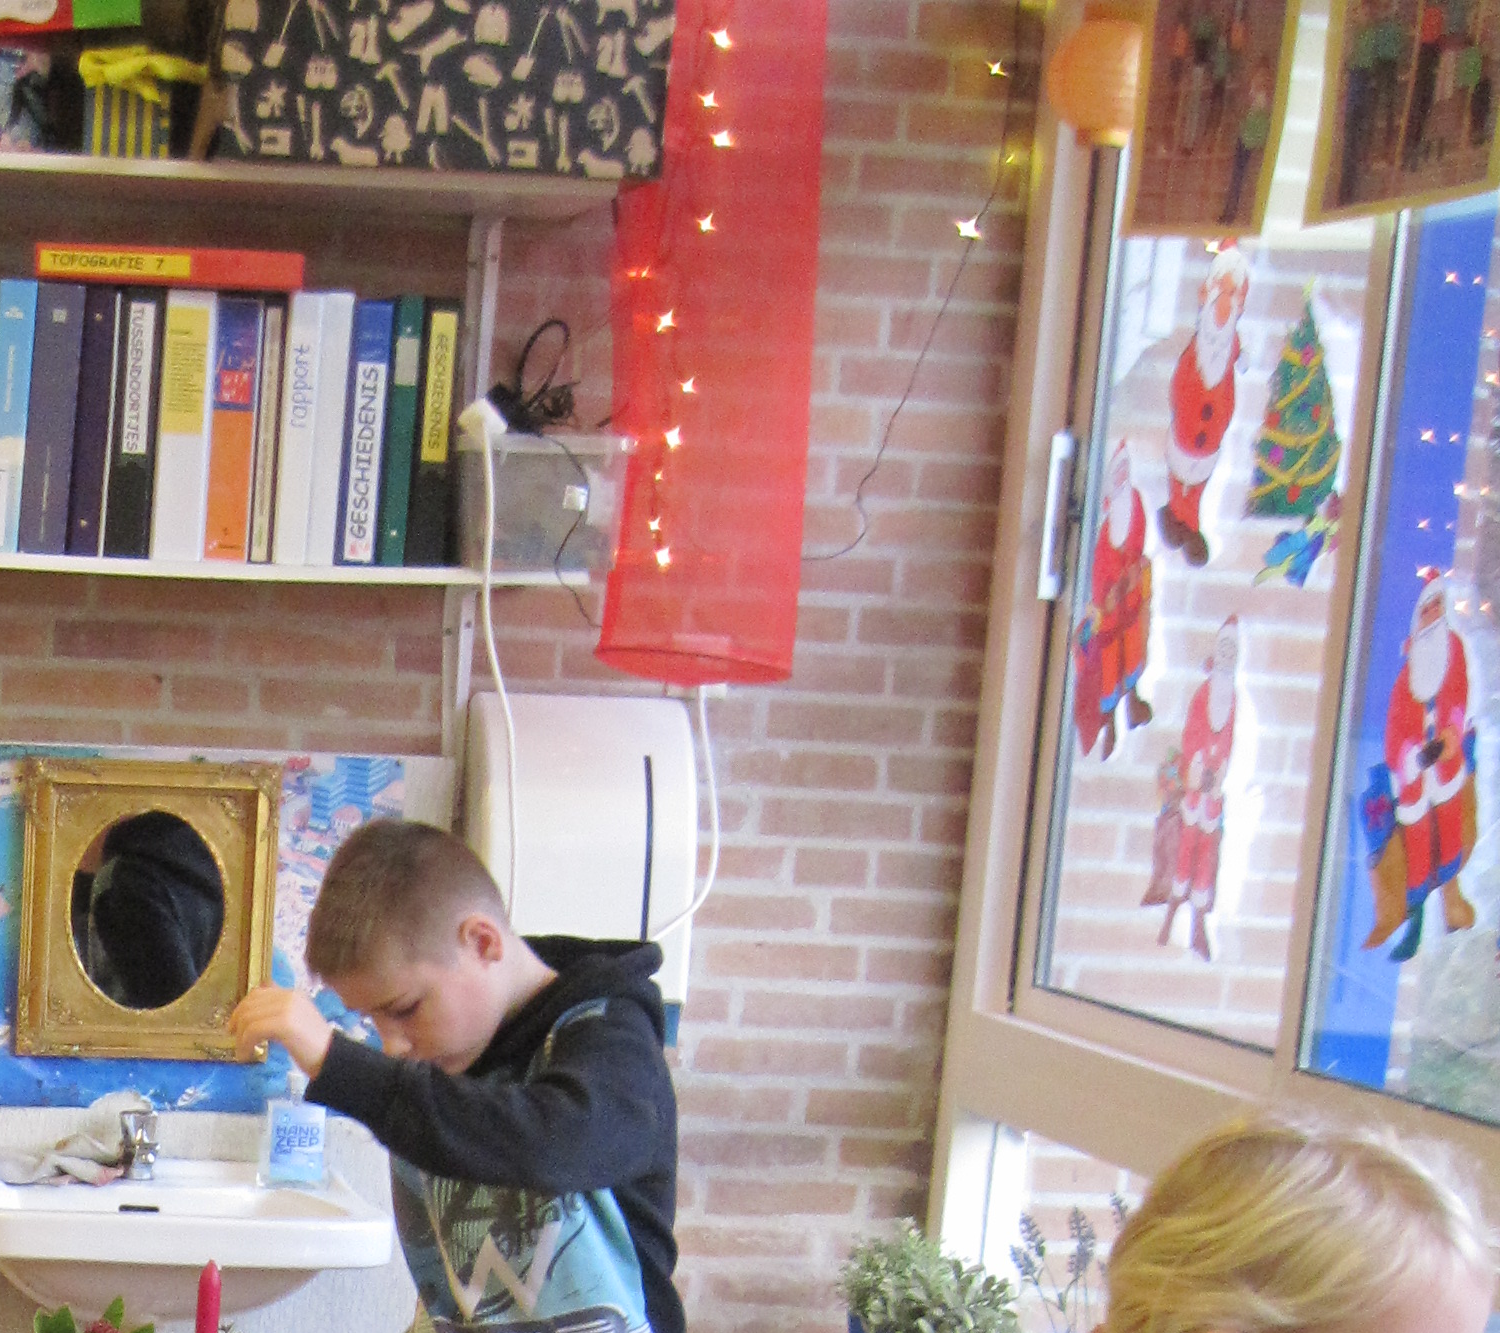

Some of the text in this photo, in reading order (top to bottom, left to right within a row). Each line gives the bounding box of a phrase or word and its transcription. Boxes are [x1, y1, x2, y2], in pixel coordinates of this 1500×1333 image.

[49, 252, 165, 271] TOPOGRAFIE 7
[125, 307, 147, 452] TUSSENDOORTJES
[290, 343, 313, 429] rapport
[428, 333, 449, 450] GESCHIEDENIS
[350, 366, 381, 540] GESCHIEDENIS
[275, 1135, 320, 1147] ZEEP
[276, 1125, 320, 1136] HAND
